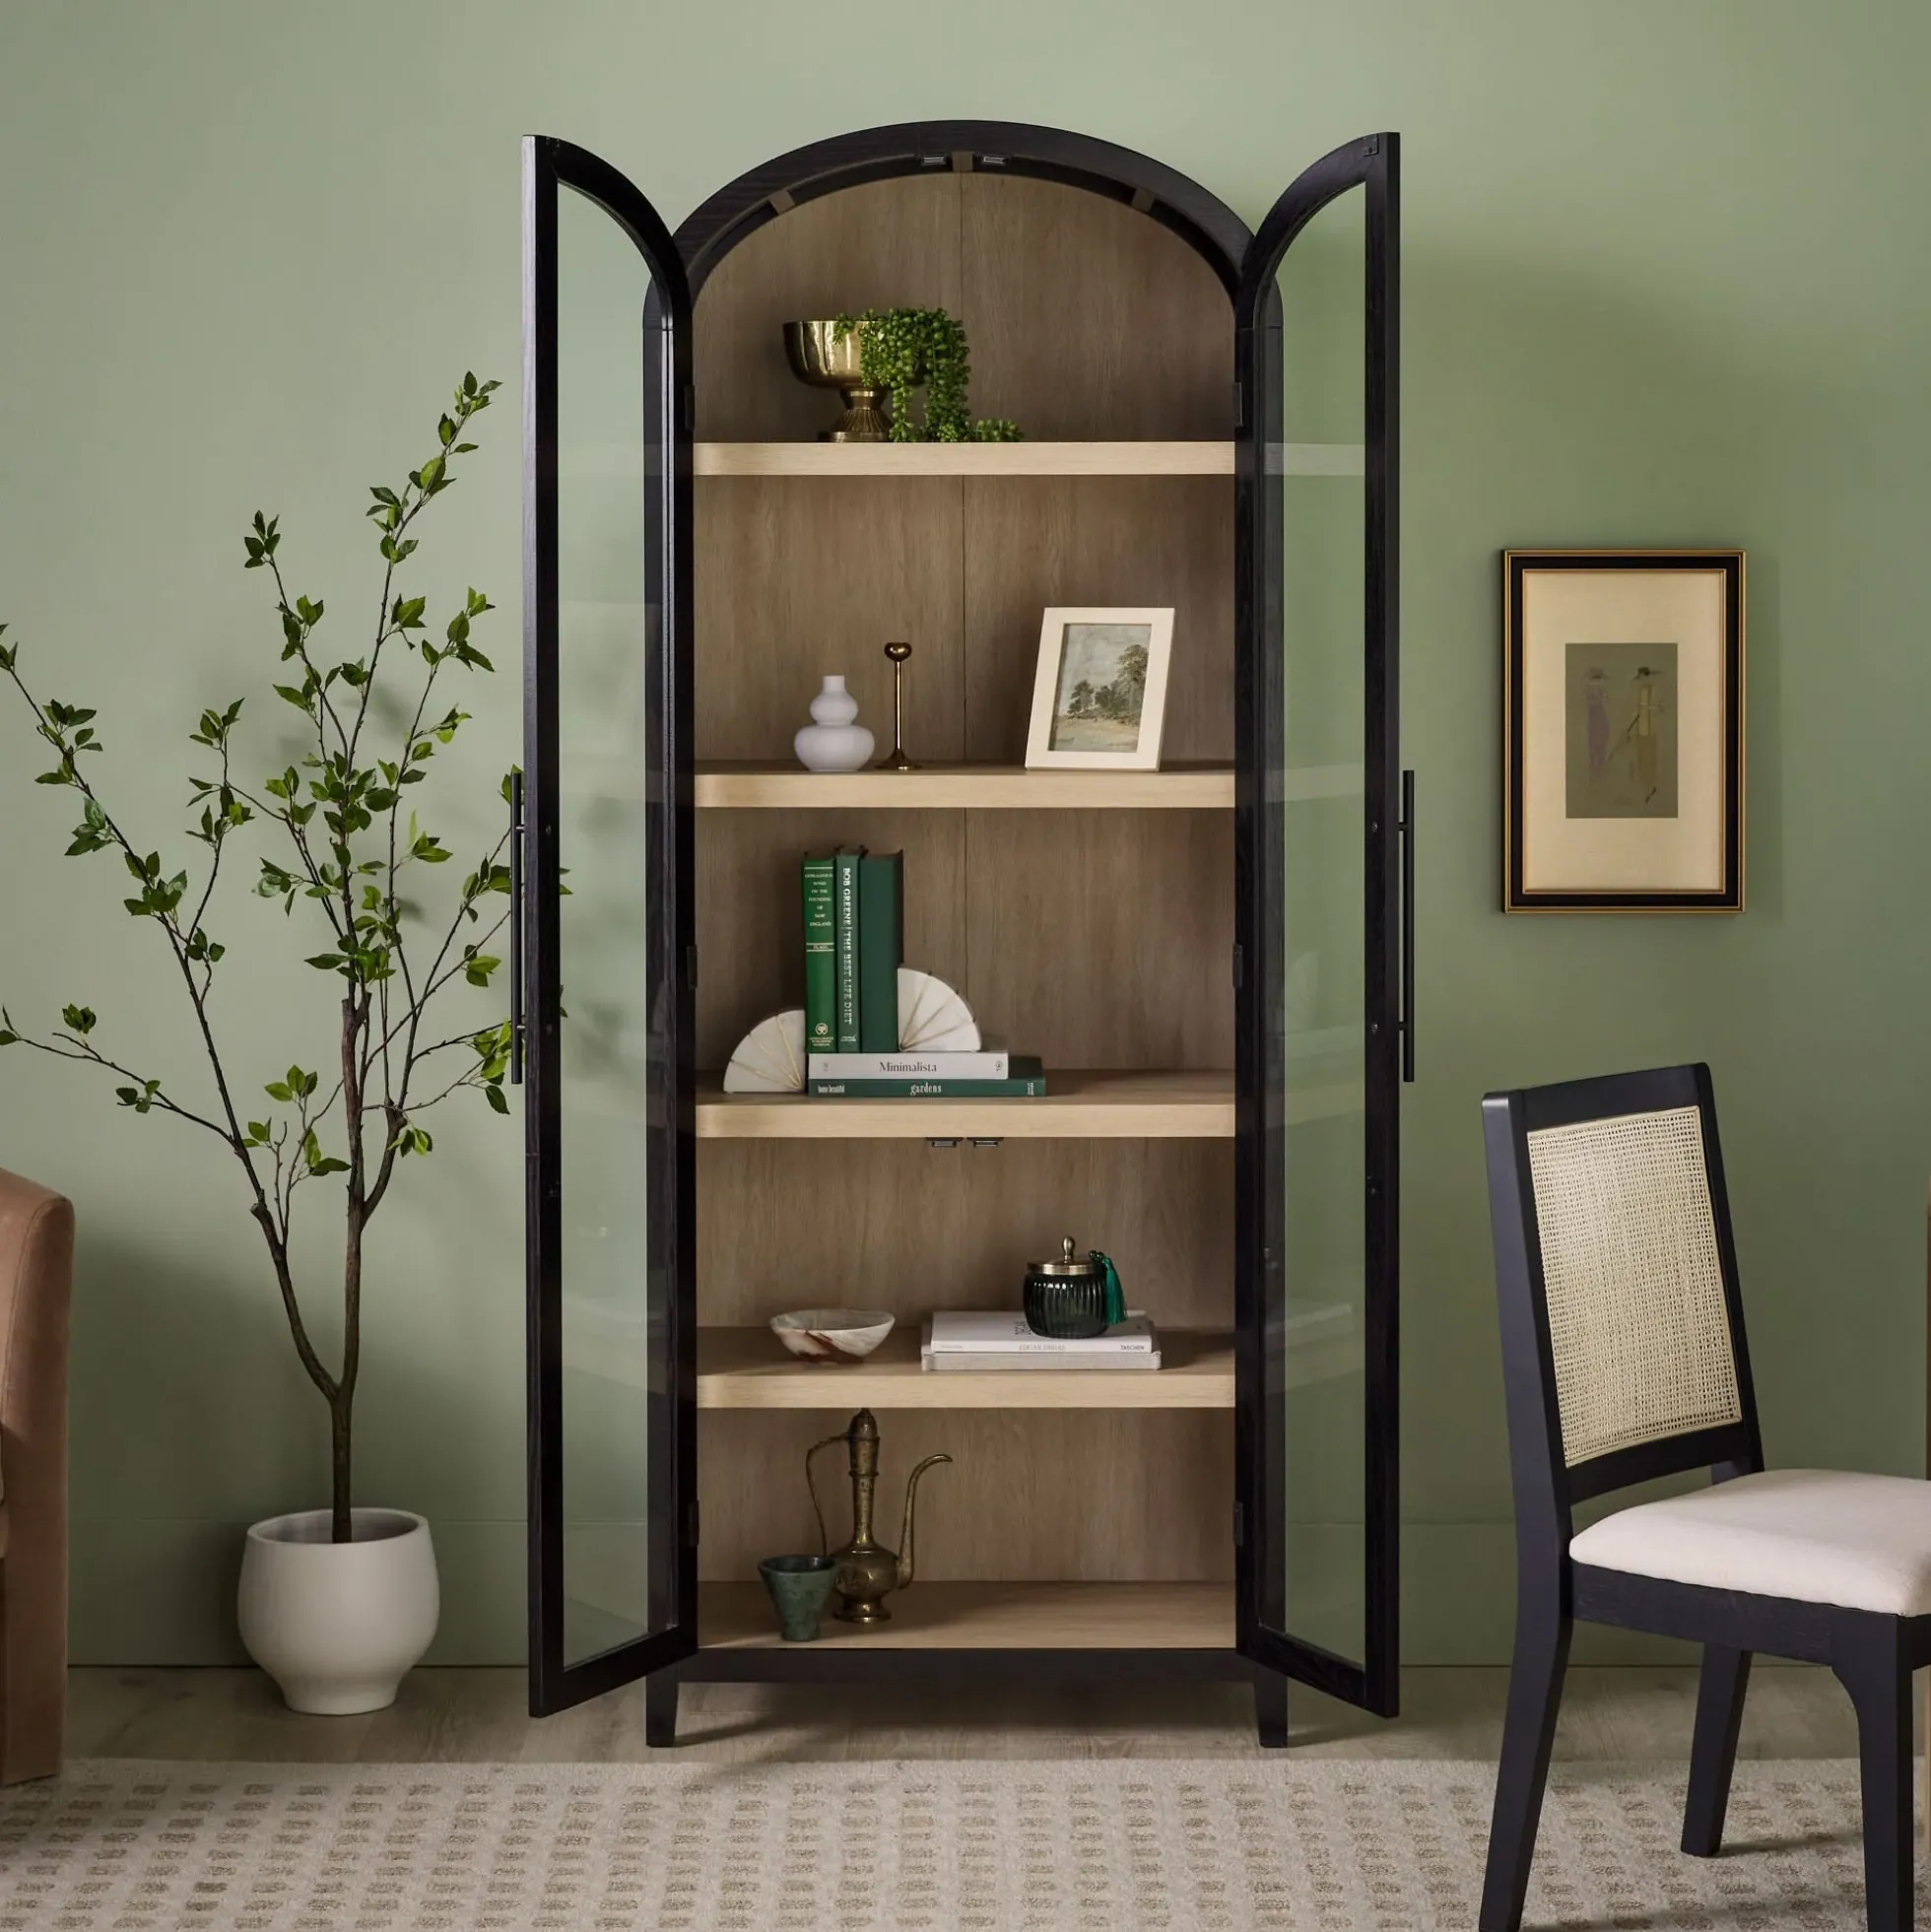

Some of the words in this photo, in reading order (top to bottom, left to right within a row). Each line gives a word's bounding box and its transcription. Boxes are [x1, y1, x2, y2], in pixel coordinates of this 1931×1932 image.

[842, 867, 851, 886] BOB
[842, 888, 852, 926] GREENE
[843, 954, 852, 977] BEST
[843, 979, 852, 999] LIFE
[843, 1002, 852, 1026] DIET
[879, 1061, 938, 1073] Minimalista
[909, 1082, 942, 1097] gardens
